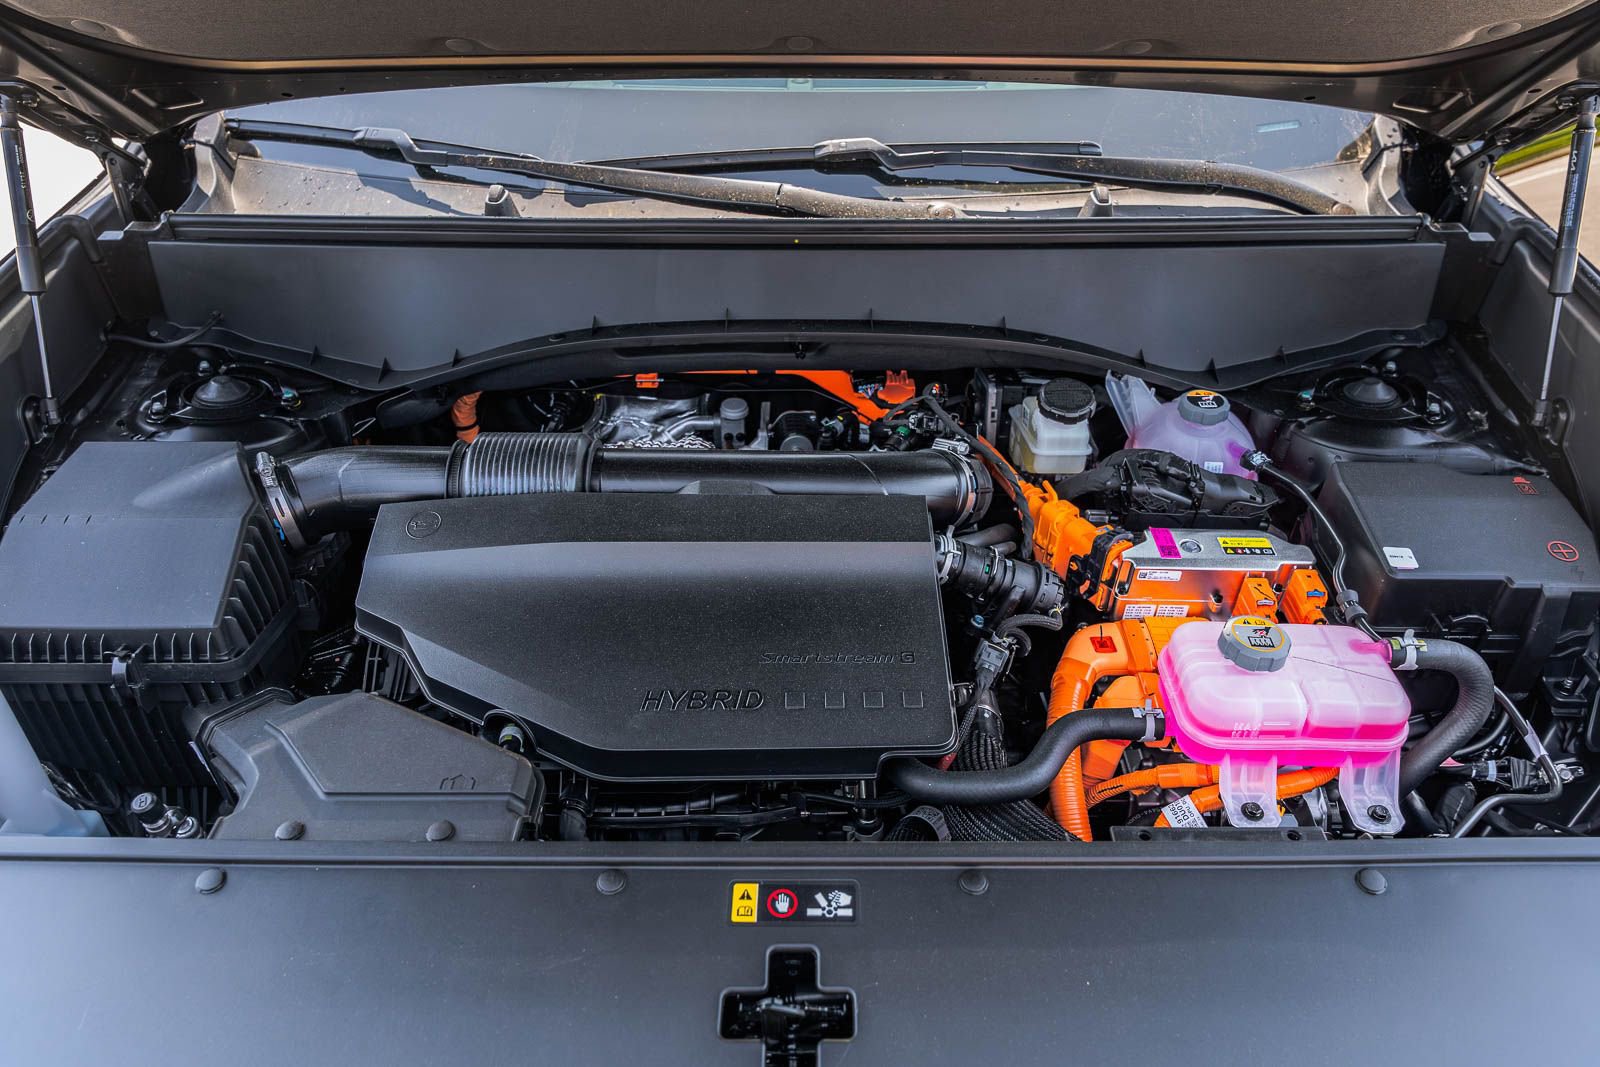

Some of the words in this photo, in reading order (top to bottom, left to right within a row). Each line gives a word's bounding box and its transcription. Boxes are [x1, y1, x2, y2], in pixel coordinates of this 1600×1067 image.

[759, 652, 896, 664] Smartstream
[900, 651, 916, 665] G
[640, 690, 764, 711] HYBRID
